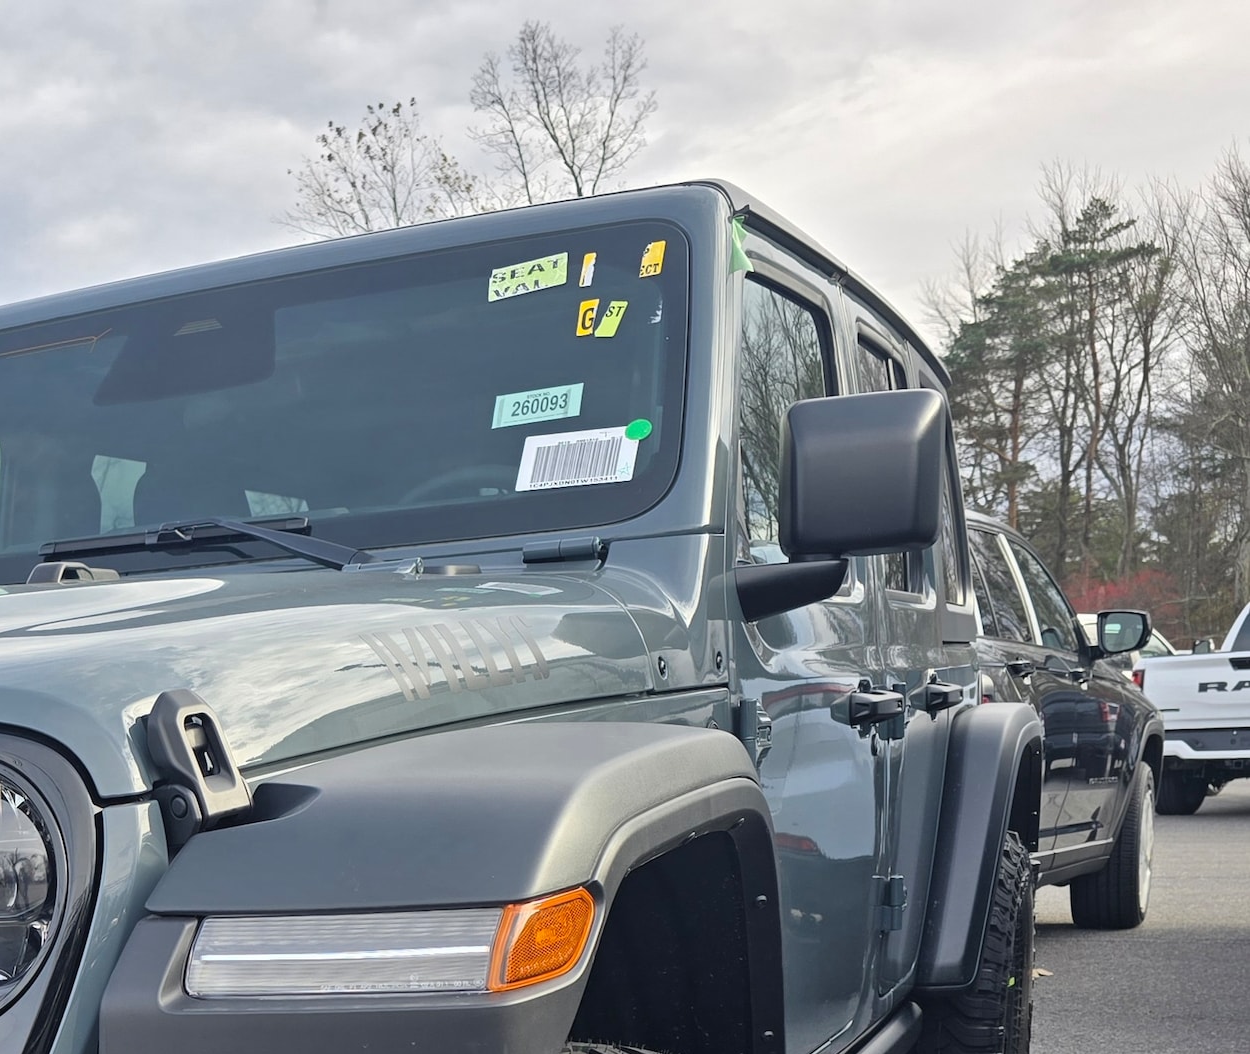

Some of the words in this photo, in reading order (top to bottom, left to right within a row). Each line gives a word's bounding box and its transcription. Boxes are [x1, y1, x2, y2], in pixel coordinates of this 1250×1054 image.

[492, 258, 565, 284] SEAT
[581, 307, 595, 330] G
[605, 305, 625, 318] ST
[511, 393, 568, 417] 260093
[357, 615, 550, 701] WILLYS
